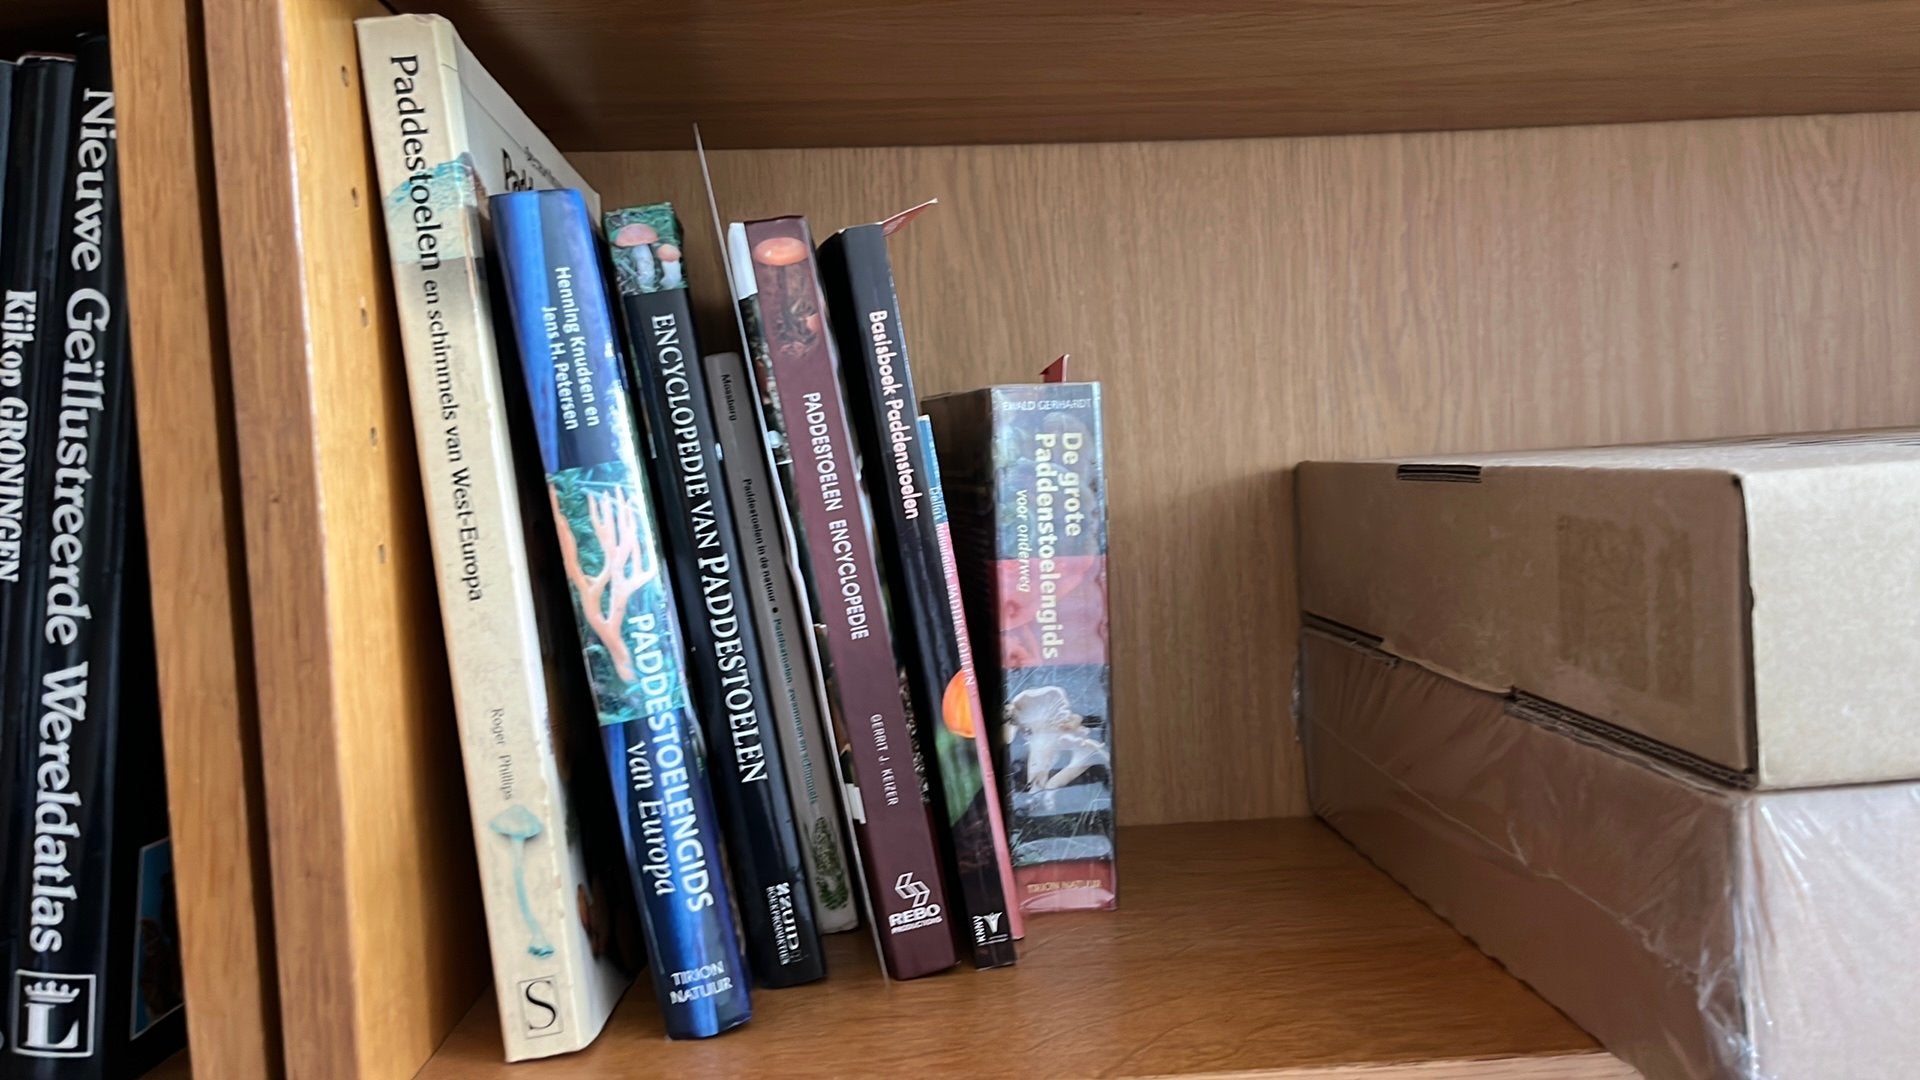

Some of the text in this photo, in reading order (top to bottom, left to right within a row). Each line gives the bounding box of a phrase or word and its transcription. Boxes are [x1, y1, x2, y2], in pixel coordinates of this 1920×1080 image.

[390, 54, 482, 602] Paddestoelen en schimmels van West-Europa
[542, 306, 579, 430] Jens H. Petersen
[555, 267, 600, 427] Henning Knudsen en
[0, 289, 37, 582] Kijk op GRONINGEN
[869, 309, 923, 520] Basisboek Paddenstoelen
[1059, 432, 1083, 537] De grote
[30, 87, 117, 954] Nieuwe Geïllustreerde Wereldatlas
[652, 313, 767, 784] ENCYCLOPEDIE VAN PADDESTOELEN
[803, 393, 870, 641] PADDESTOELEN ENCYCLOPEDIE
[1016, 489, 1029, 524] voor
[1035, 433, 1065, 660] Paddenstoelengids
[491, 708, 504, 746] Roger
[628, 613, 714, 912] PADDESTOELENGIDS
[881, 768, 900, 806] KEIZER
[627, 740, 675, 896] van Europa
[670, 961, 724, 986] TIRION
[888, 904, 940, 927] REBO
[22, 1003, 79, 1049] L
[525, 981, 557, 1032] S
[669, 977, 733, 1004] NATUUR
